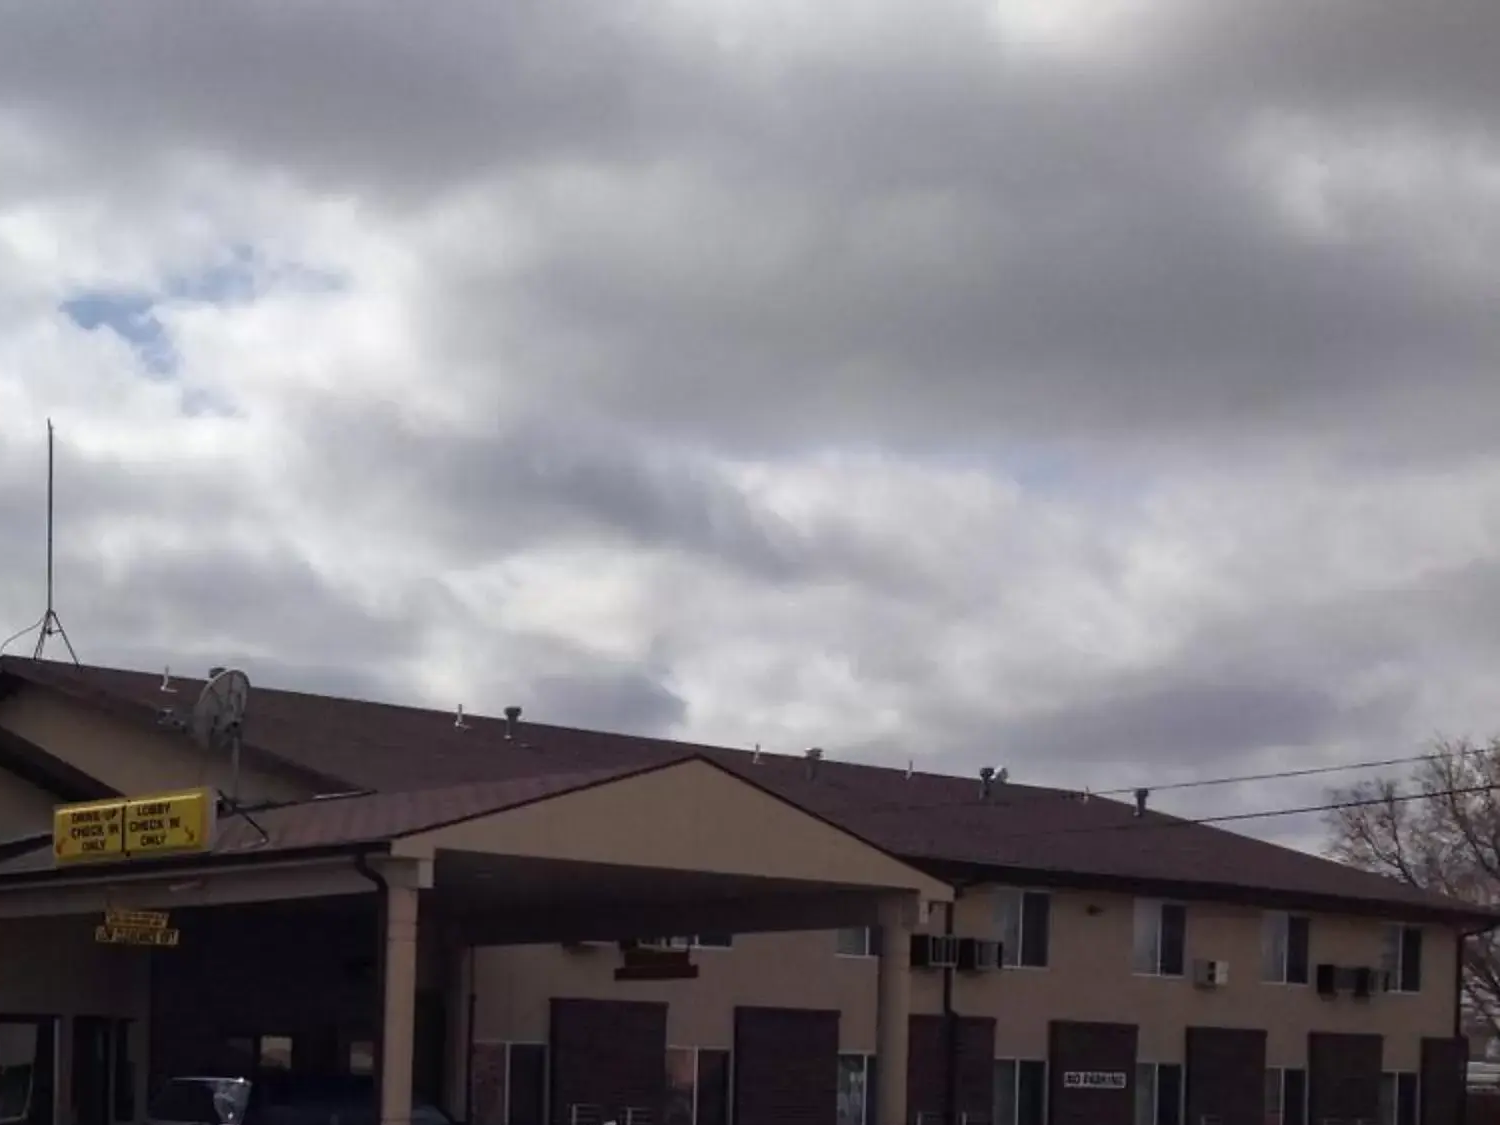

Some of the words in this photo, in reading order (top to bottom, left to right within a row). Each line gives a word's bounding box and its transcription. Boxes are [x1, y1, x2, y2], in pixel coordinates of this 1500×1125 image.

[137, 802, 170, 815] LOBBY
[71, 825, 104, 840] CHECK
[130, 820, 164, 833] CHECK
[82, 839, 105, 851] ONLY
[140, 832, 166, 846] ONLY
[1067, 1074, 1080, 1084] NO
[1083, 1074, 1124, 1085] PARKING
